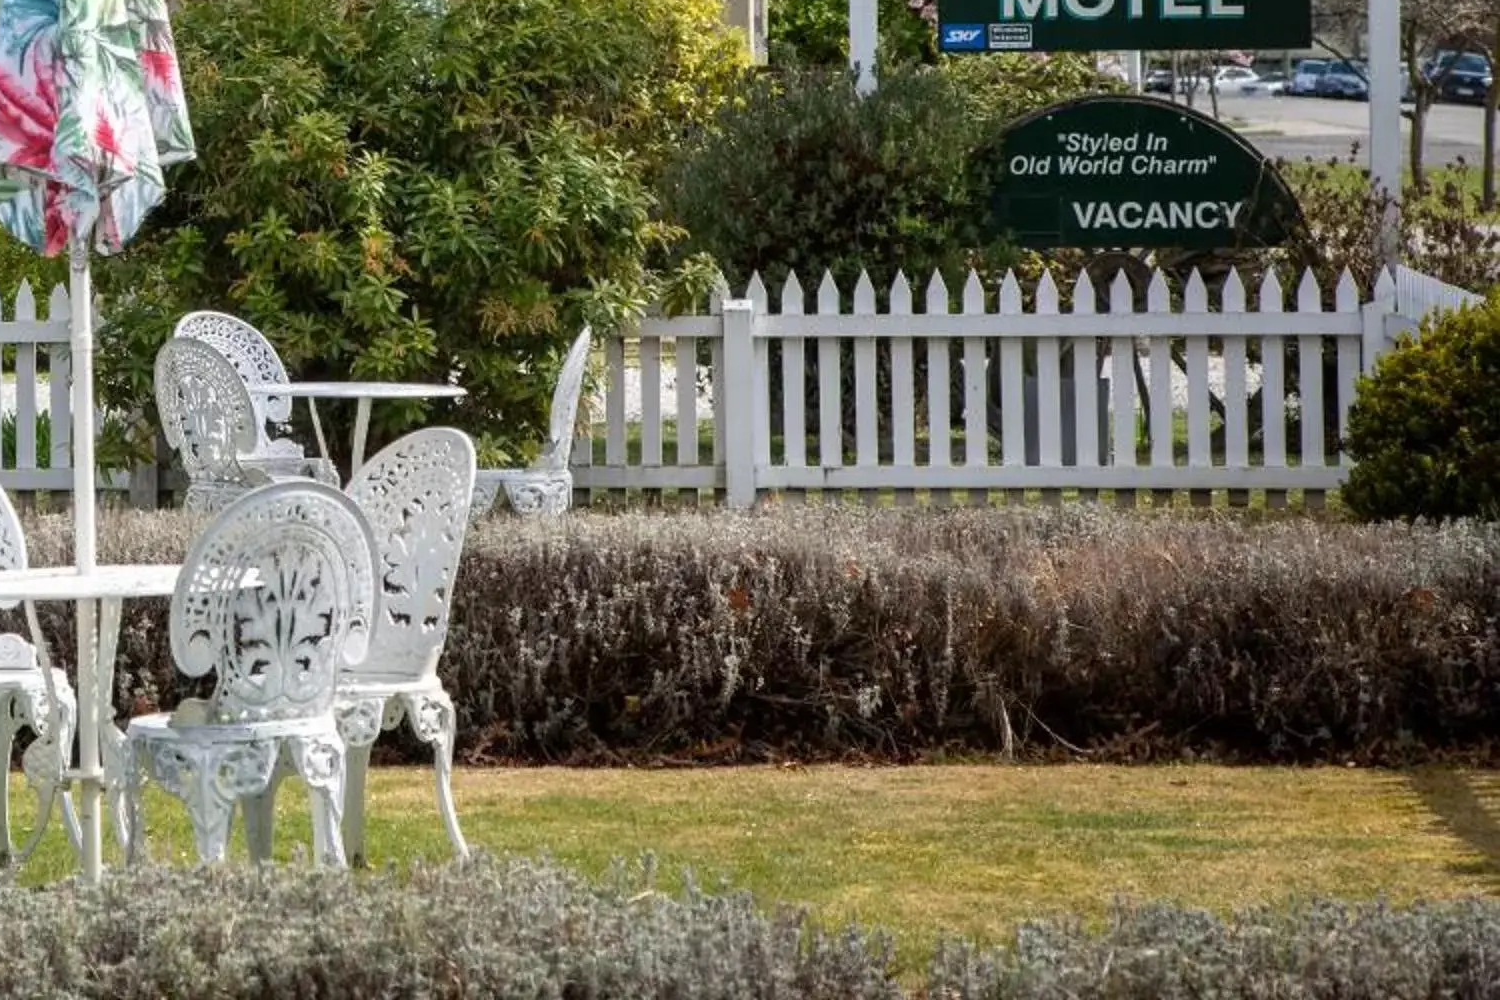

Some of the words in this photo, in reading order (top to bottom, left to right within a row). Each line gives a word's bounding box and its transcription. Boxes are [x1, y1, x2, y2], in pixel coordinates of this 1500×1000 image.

[1057, 132, 1139, 157] "Styled
[1146, 133, 1168, 152] In
[1010, 155, 1051, 175] Old
[1058, 155, 1124, 175] World
[1131, 155, 1218, 175] Charm"
[1071, 201, 1244, 229] VACANCY
